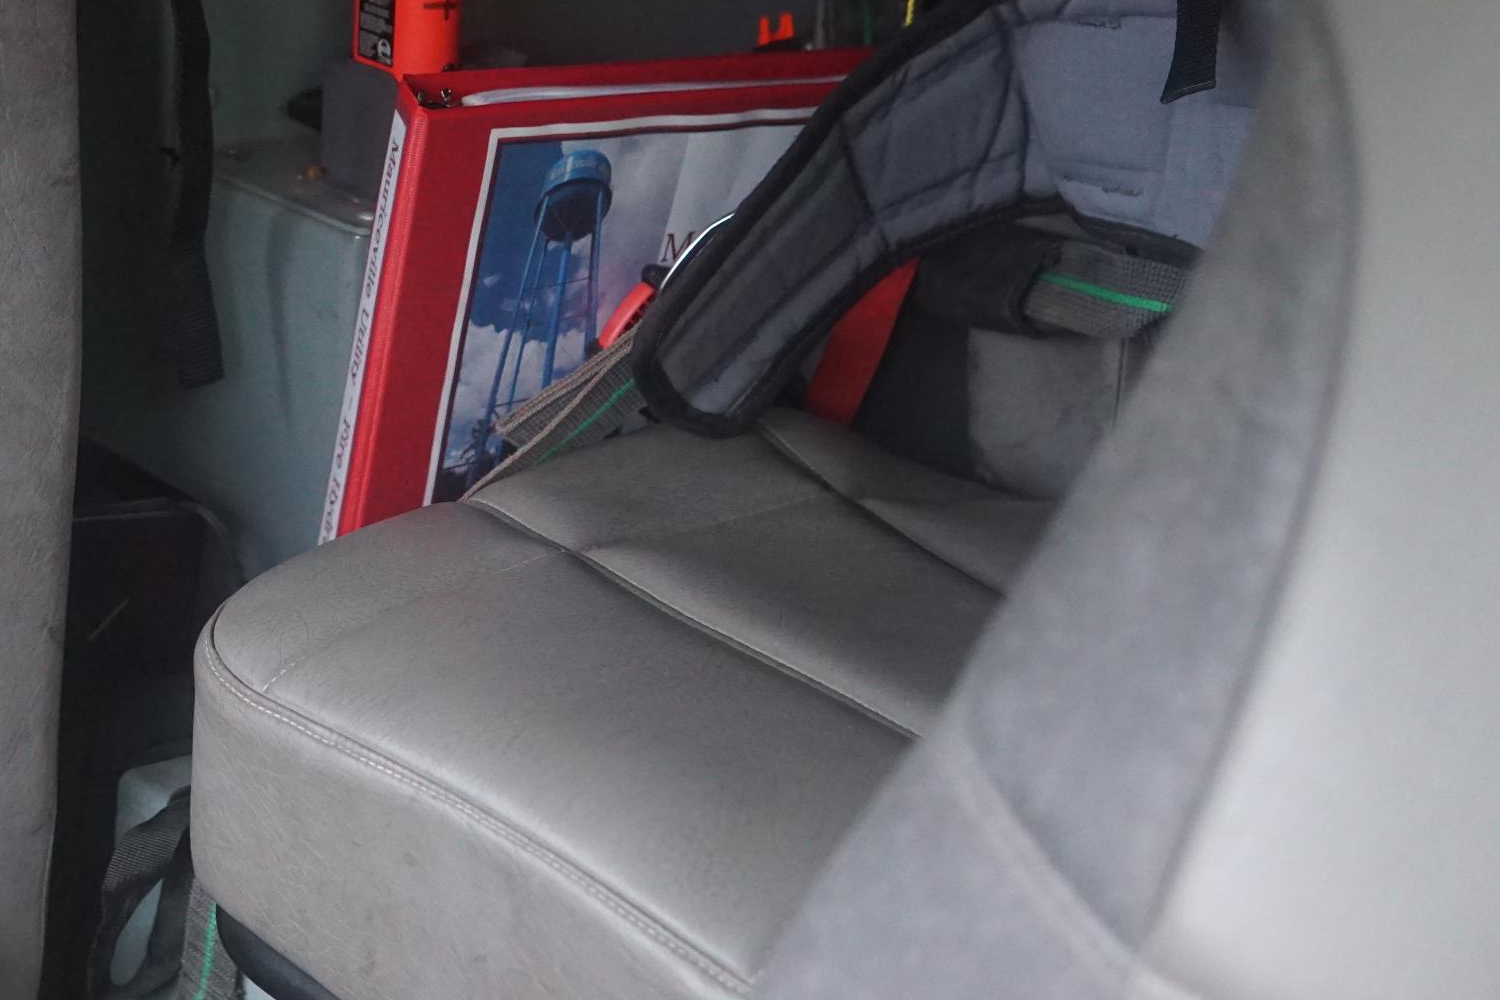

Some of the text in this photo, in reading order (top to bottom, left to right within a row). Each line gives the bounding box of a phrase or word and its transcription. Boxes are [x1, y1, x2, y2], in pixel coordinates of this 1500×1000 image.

[365, 137, 400, 298] Mauriceville
[351, 308, 370, 385] Utility
[335, 417, 351, 469] Fire
